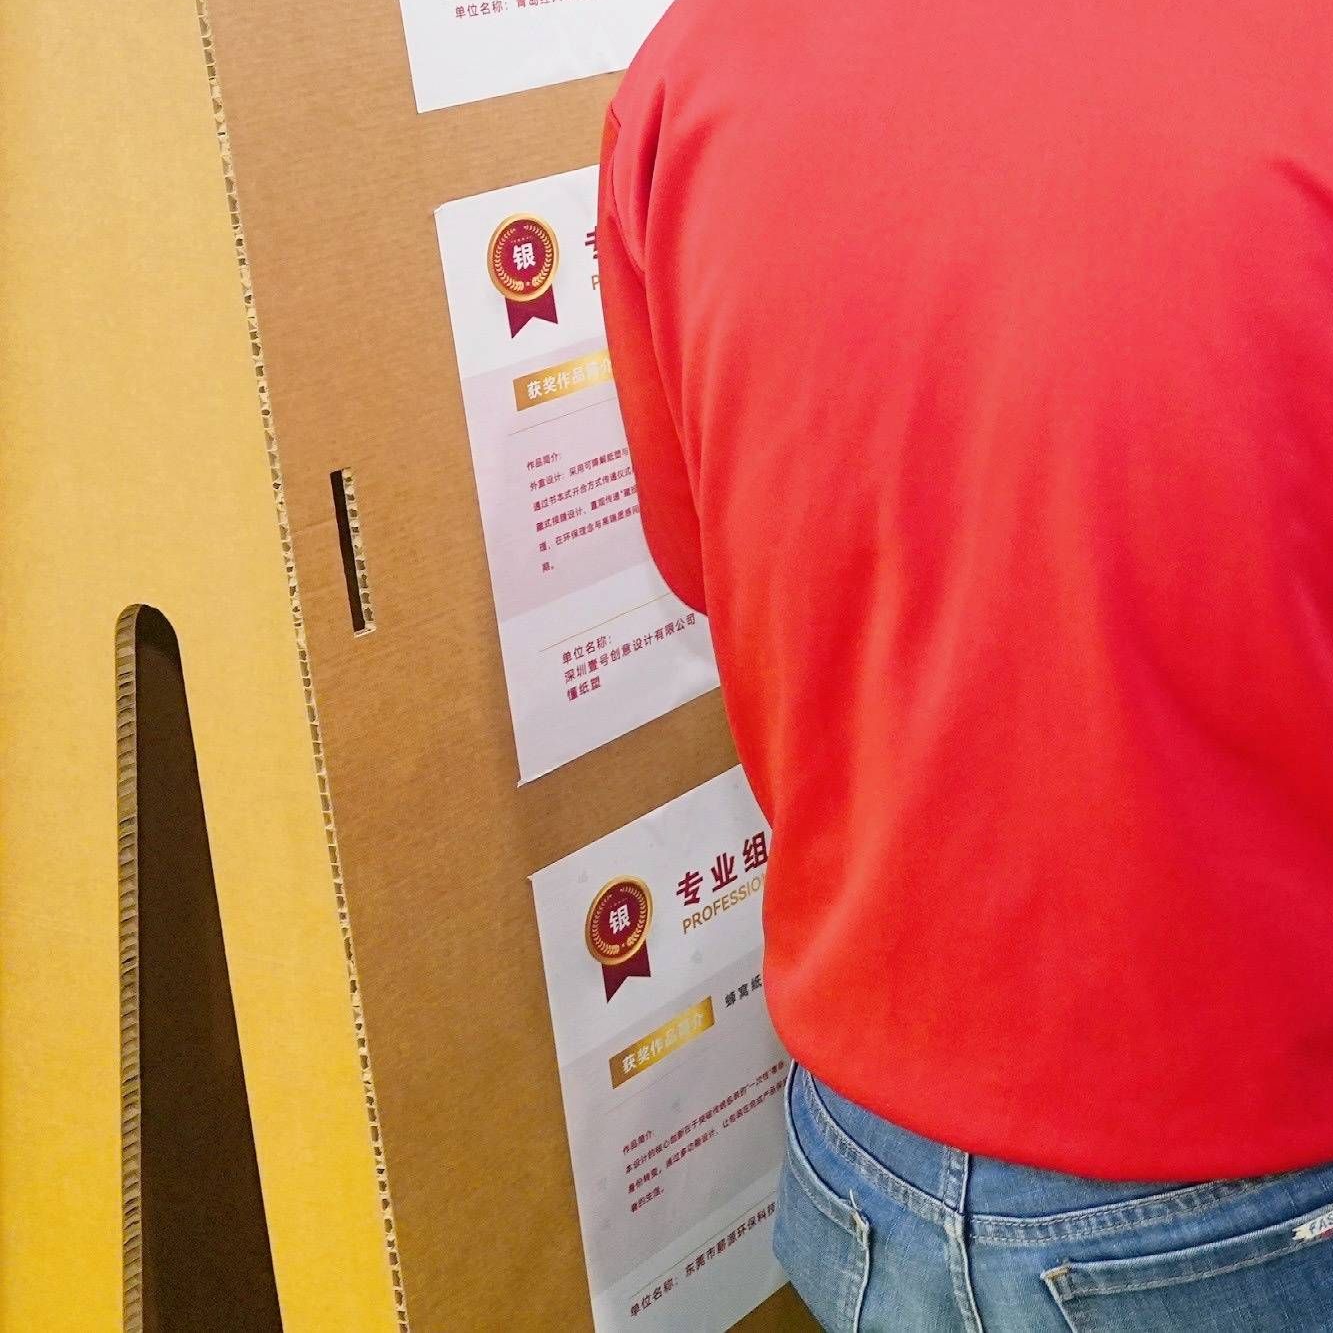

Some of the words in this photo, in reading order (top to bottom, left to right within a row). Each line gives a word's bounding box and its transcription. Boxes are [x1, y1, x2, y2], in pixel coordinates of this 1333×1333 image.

[512, 242, 536, 271] 银
[608, 903, 631, 934] 银
[682, 874, 763, 935] PROFESSIO
